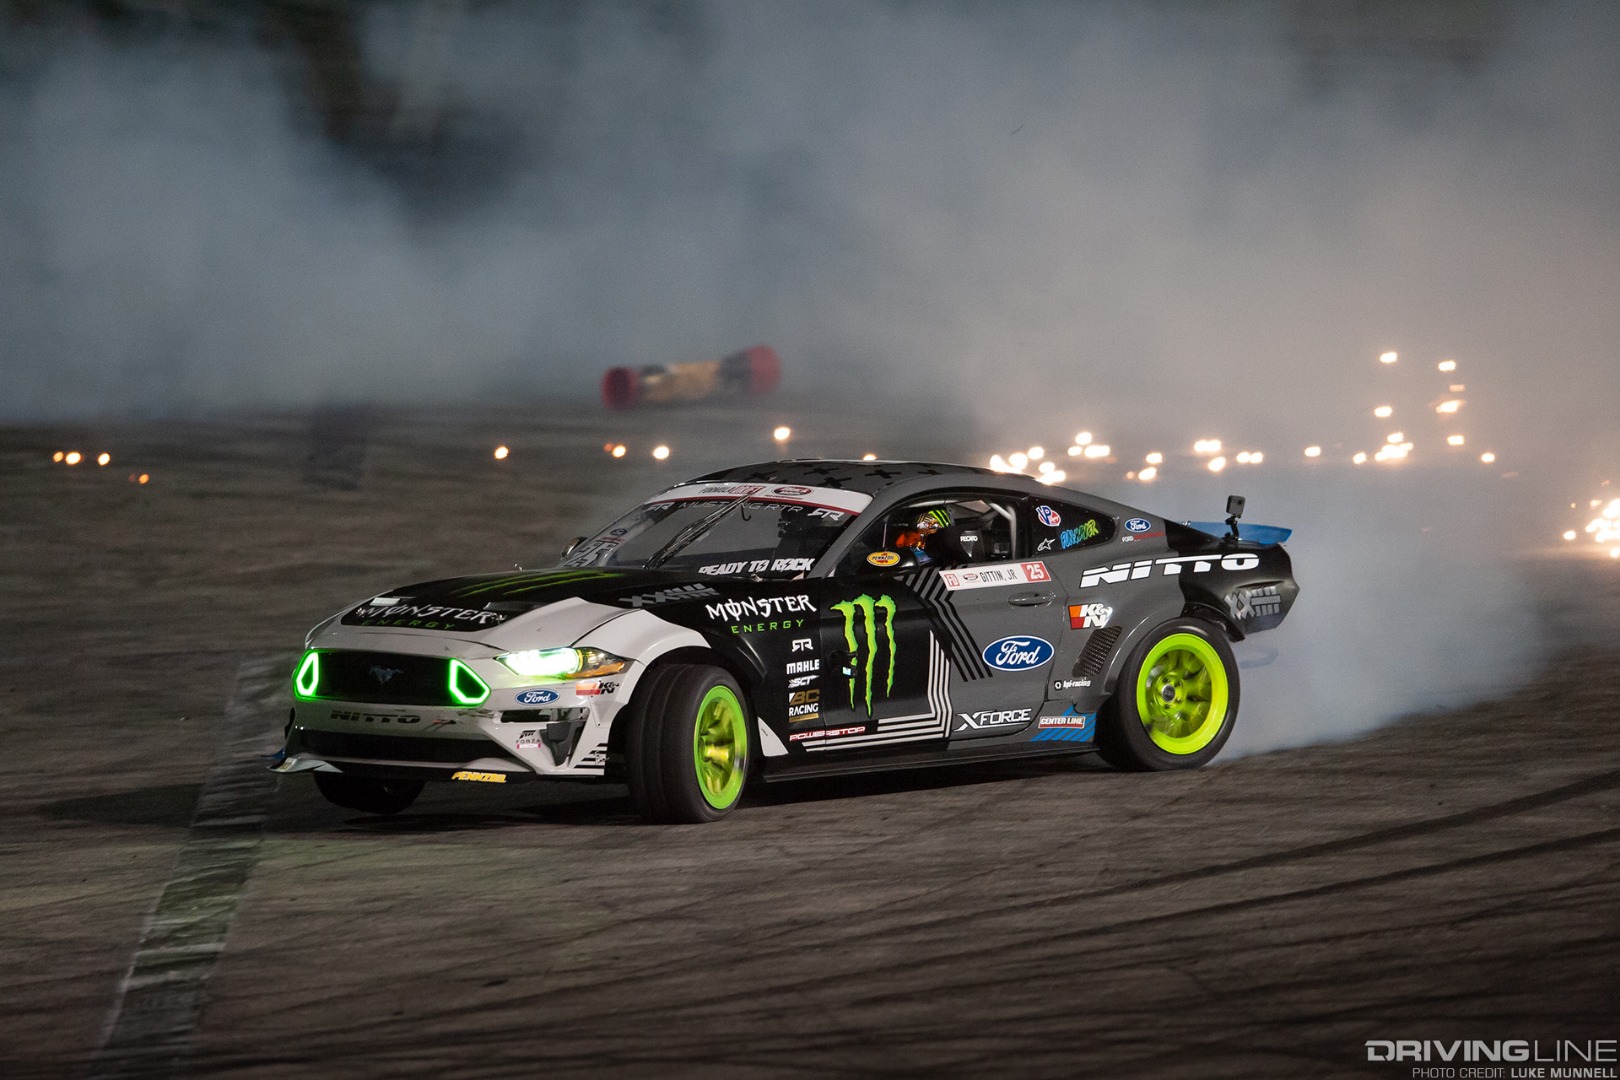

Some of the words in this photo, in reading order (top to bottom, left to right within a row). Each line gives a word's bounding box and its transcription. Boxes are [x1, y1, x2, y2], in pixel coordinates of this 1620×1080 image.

[679, 501, 763, 512] MUSTNG
[764, 503, 803, 513] RTR
[1129, 520, 1147, 531] Ford
[698, 560, 746, 576] READY
[747, 559, 768, 573] TO
[771, 558, 816, 573] ROCK
[1008, 569, 1018, 580] JR
[1027, 563, 1046, 580] 25
[1080, 553, 1260, 588] NITTO
[363, 603, 492, 624] MONSTER
[705, 594, 817, 622] MONSTER
[361, 619, 456, 630] ENERGY
[731, 619, 805, 634] ENERGY
[792, 638, 814, 652] RTR
[995, 640, 1041, 665] Ford
[786, 659, 820, 675] MAHLE
[1063, 678, 1091, 691] hpi-racing
[523, 691, 551, 703] Ford
[790, 689, 820, 705] BC
[330, 709, 421, 724] NITTO
[788, 703, 819, 717] RACING
[953, 708, 1032, 732] XFORCE
[1040, 716, 1066, 725] CENTER
[1067, 715, 1084, 724] LINE
[789, 726, 866, 742] POWERSTOP
[451, 771, 507, 783] PENNZOIL
